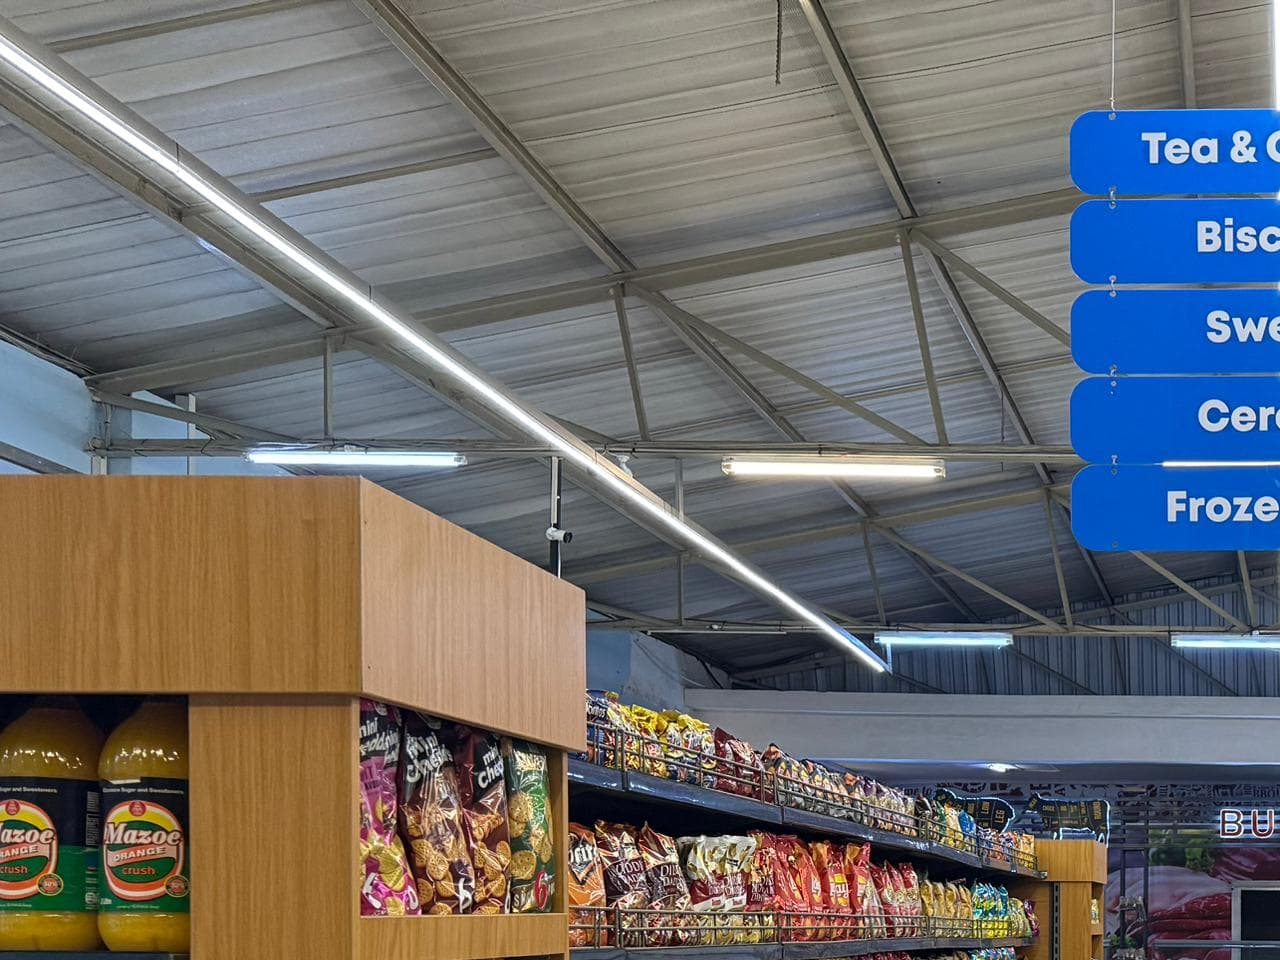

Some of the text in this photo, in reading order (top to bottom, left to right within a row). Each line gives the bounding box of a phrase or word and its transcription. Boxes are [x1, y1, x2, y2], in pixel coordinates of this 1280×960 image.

[1141, 131, 1219, 164] Tea
[1230, 131, 1258, 164] &
[104, 821, 183, 846] Mazoe
[113, 846, 167, 862] ORANGE
[122, 867, 156, 876] crush
